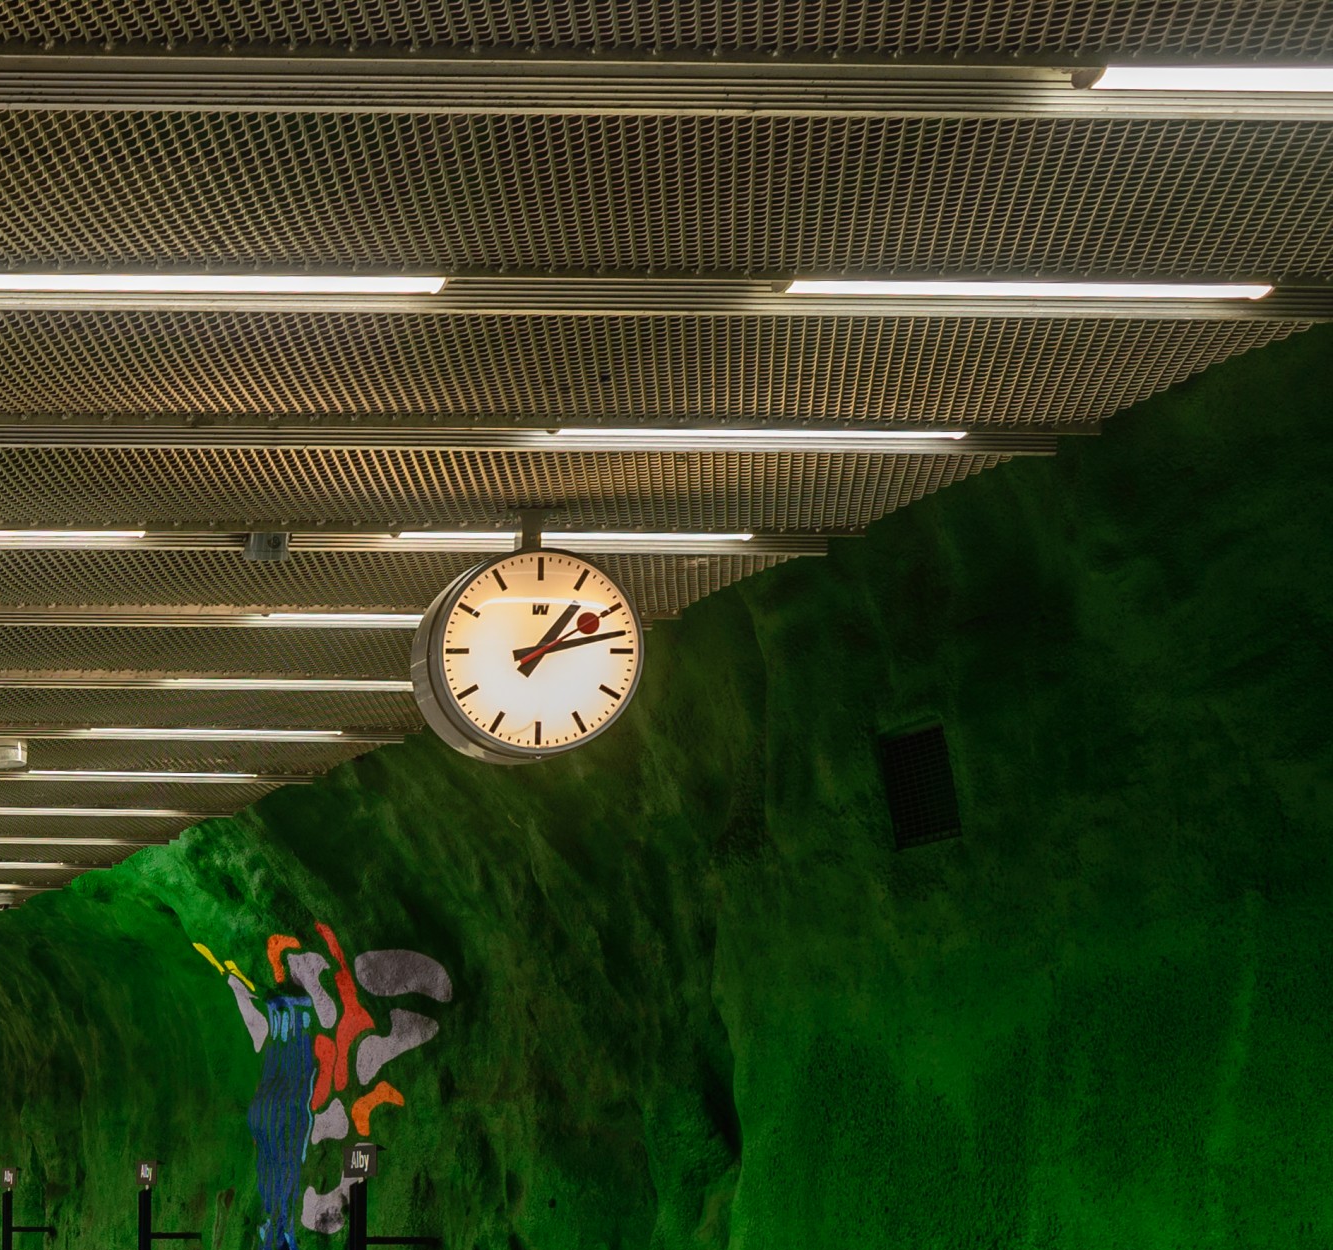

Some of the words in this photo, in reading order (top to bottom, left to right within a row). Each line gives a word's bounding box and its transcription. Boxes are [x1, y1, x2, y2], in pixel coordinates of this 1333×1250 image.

[532, 603, 549, 615] W
[351, 1151, 369, 1172] Alby
[141, 1164, 152, 1181] Alby
